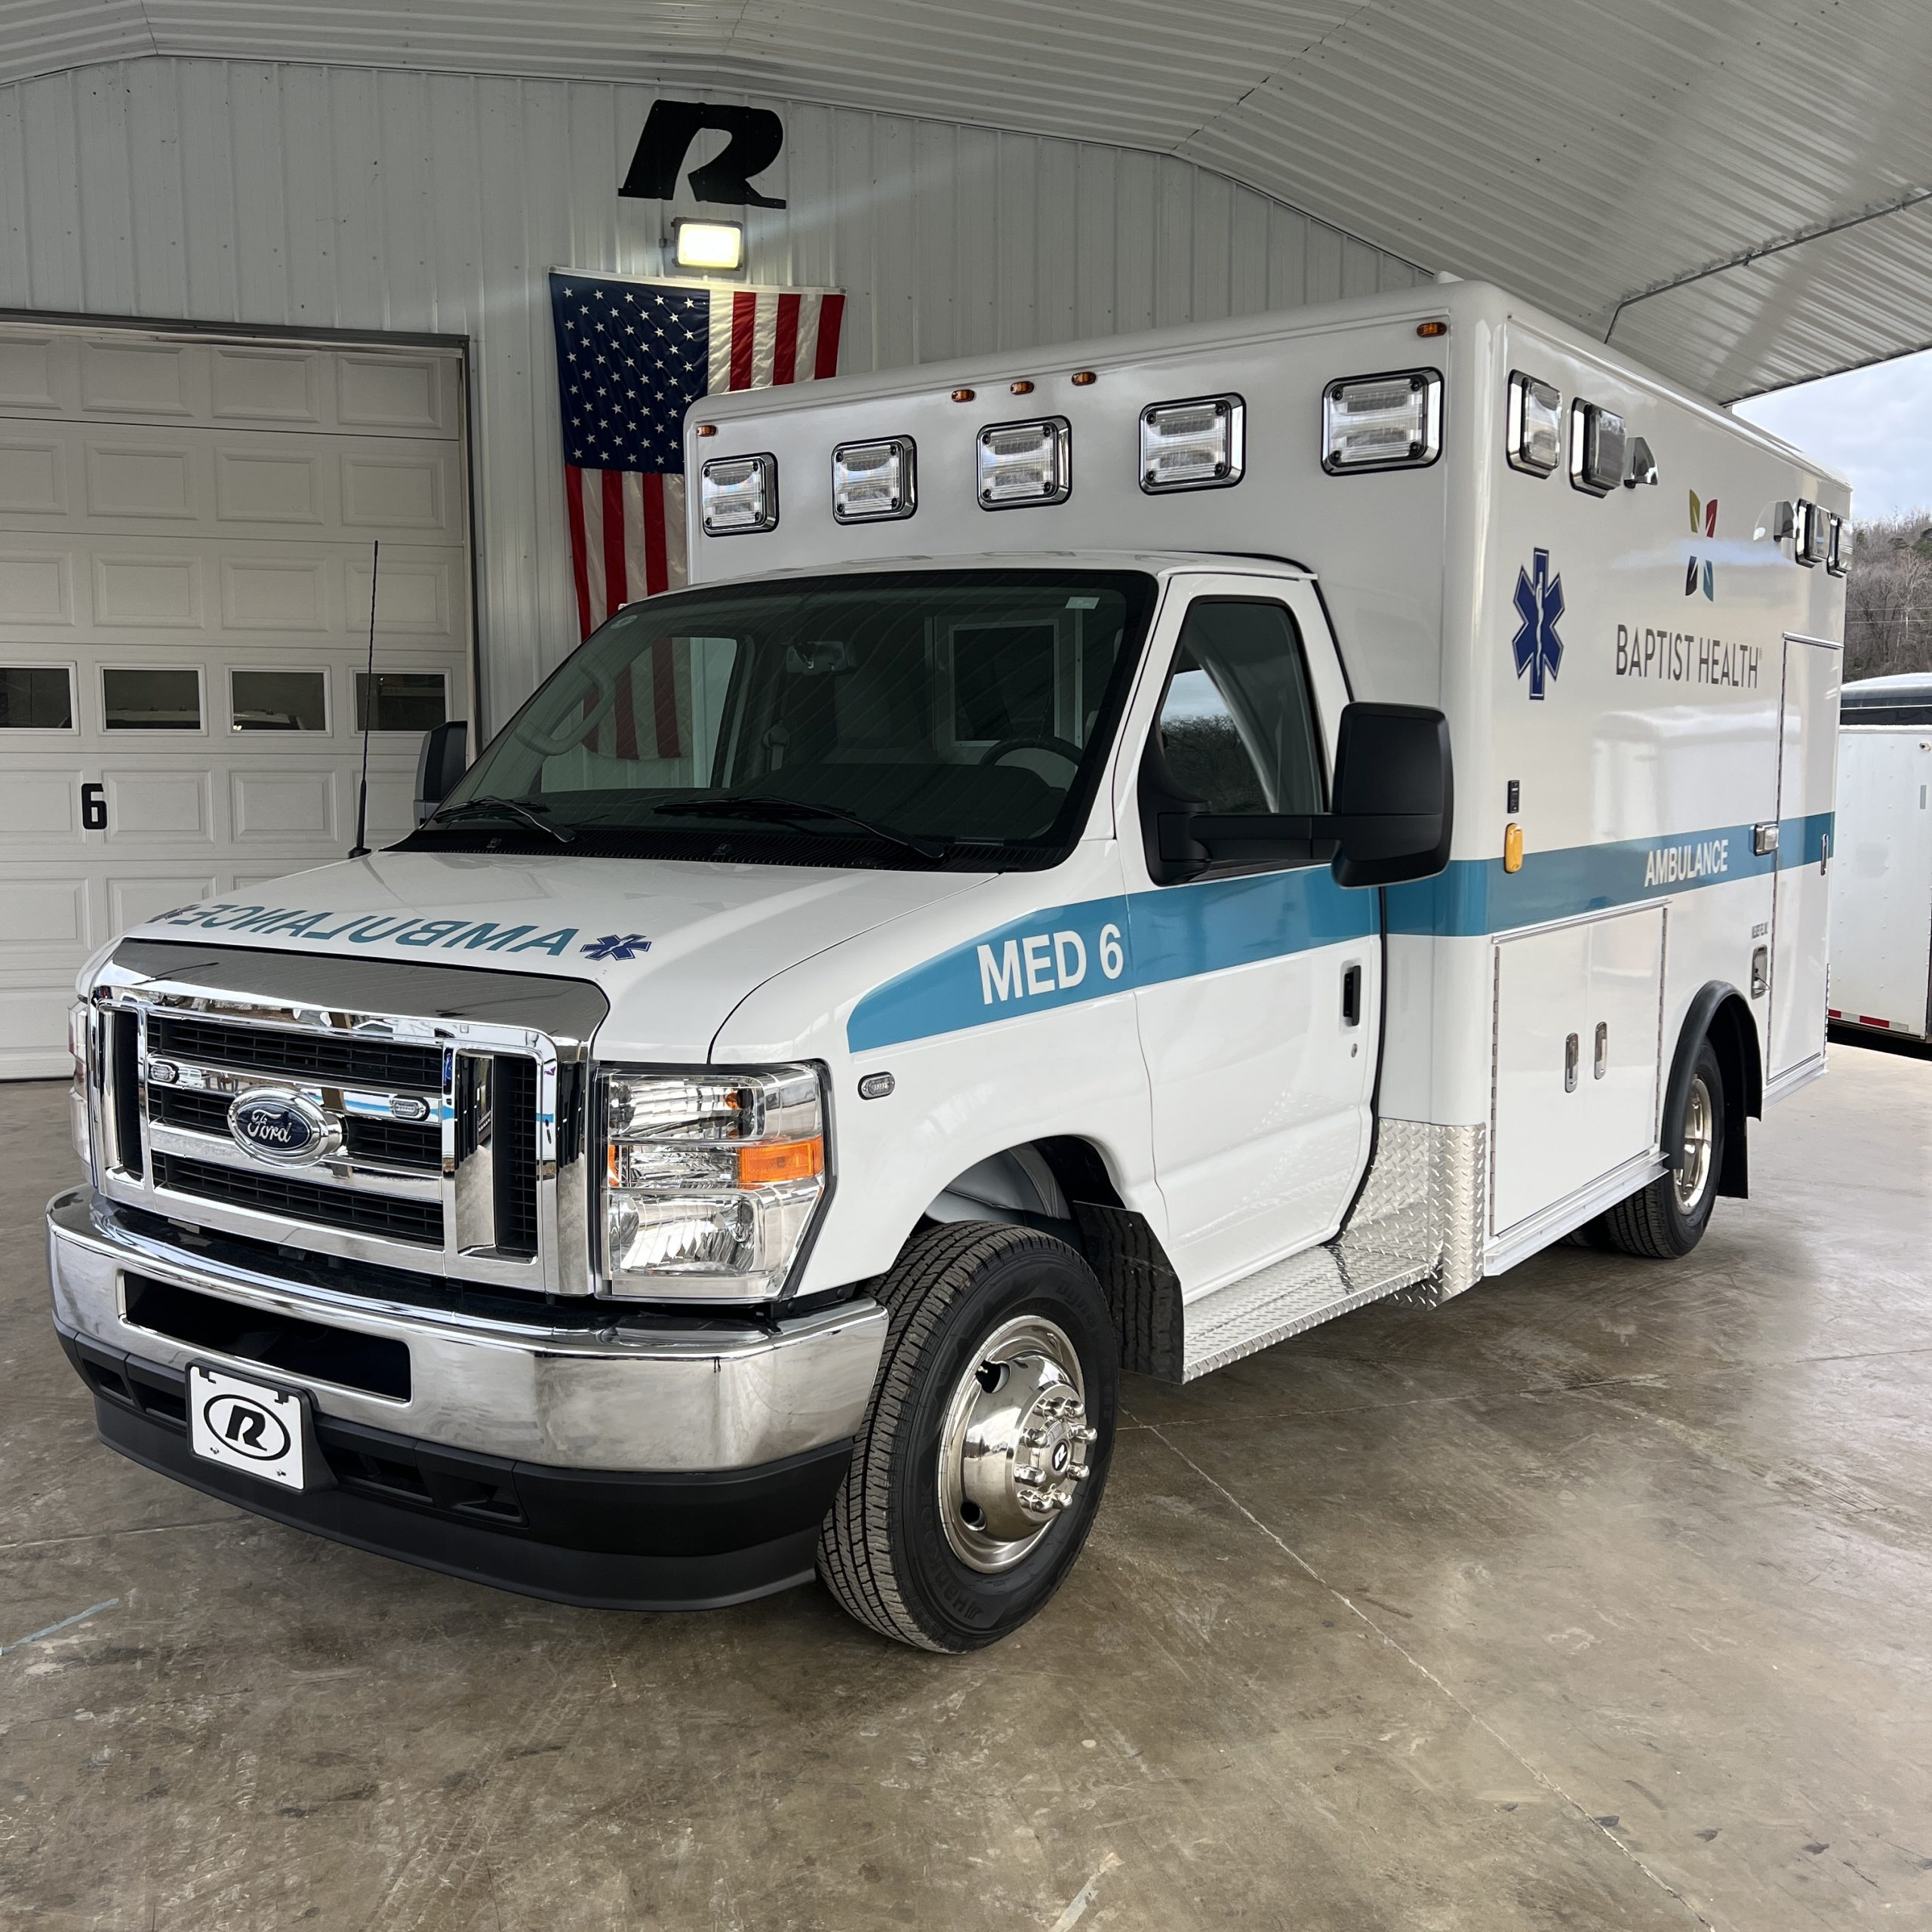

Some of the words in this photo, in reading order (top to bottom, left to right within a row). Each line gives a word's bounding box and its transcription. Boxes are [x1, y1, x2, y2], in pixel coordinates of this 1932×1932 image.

[618, 99, 786, 209] R
[1616, 624, 1694, 681] BAPTIST
[1698, 638, 1758, 688] HEALTH
[81, 783, 108, 829] 6
[1644, 839, 1729, 888] AMBULANCE
[977, 930, 1087, 1005] MED
[1099, 923, 1124, 980] 6
[247, 1109, 293, 1143] Ford
[225, 1404, 267, 1451] R
